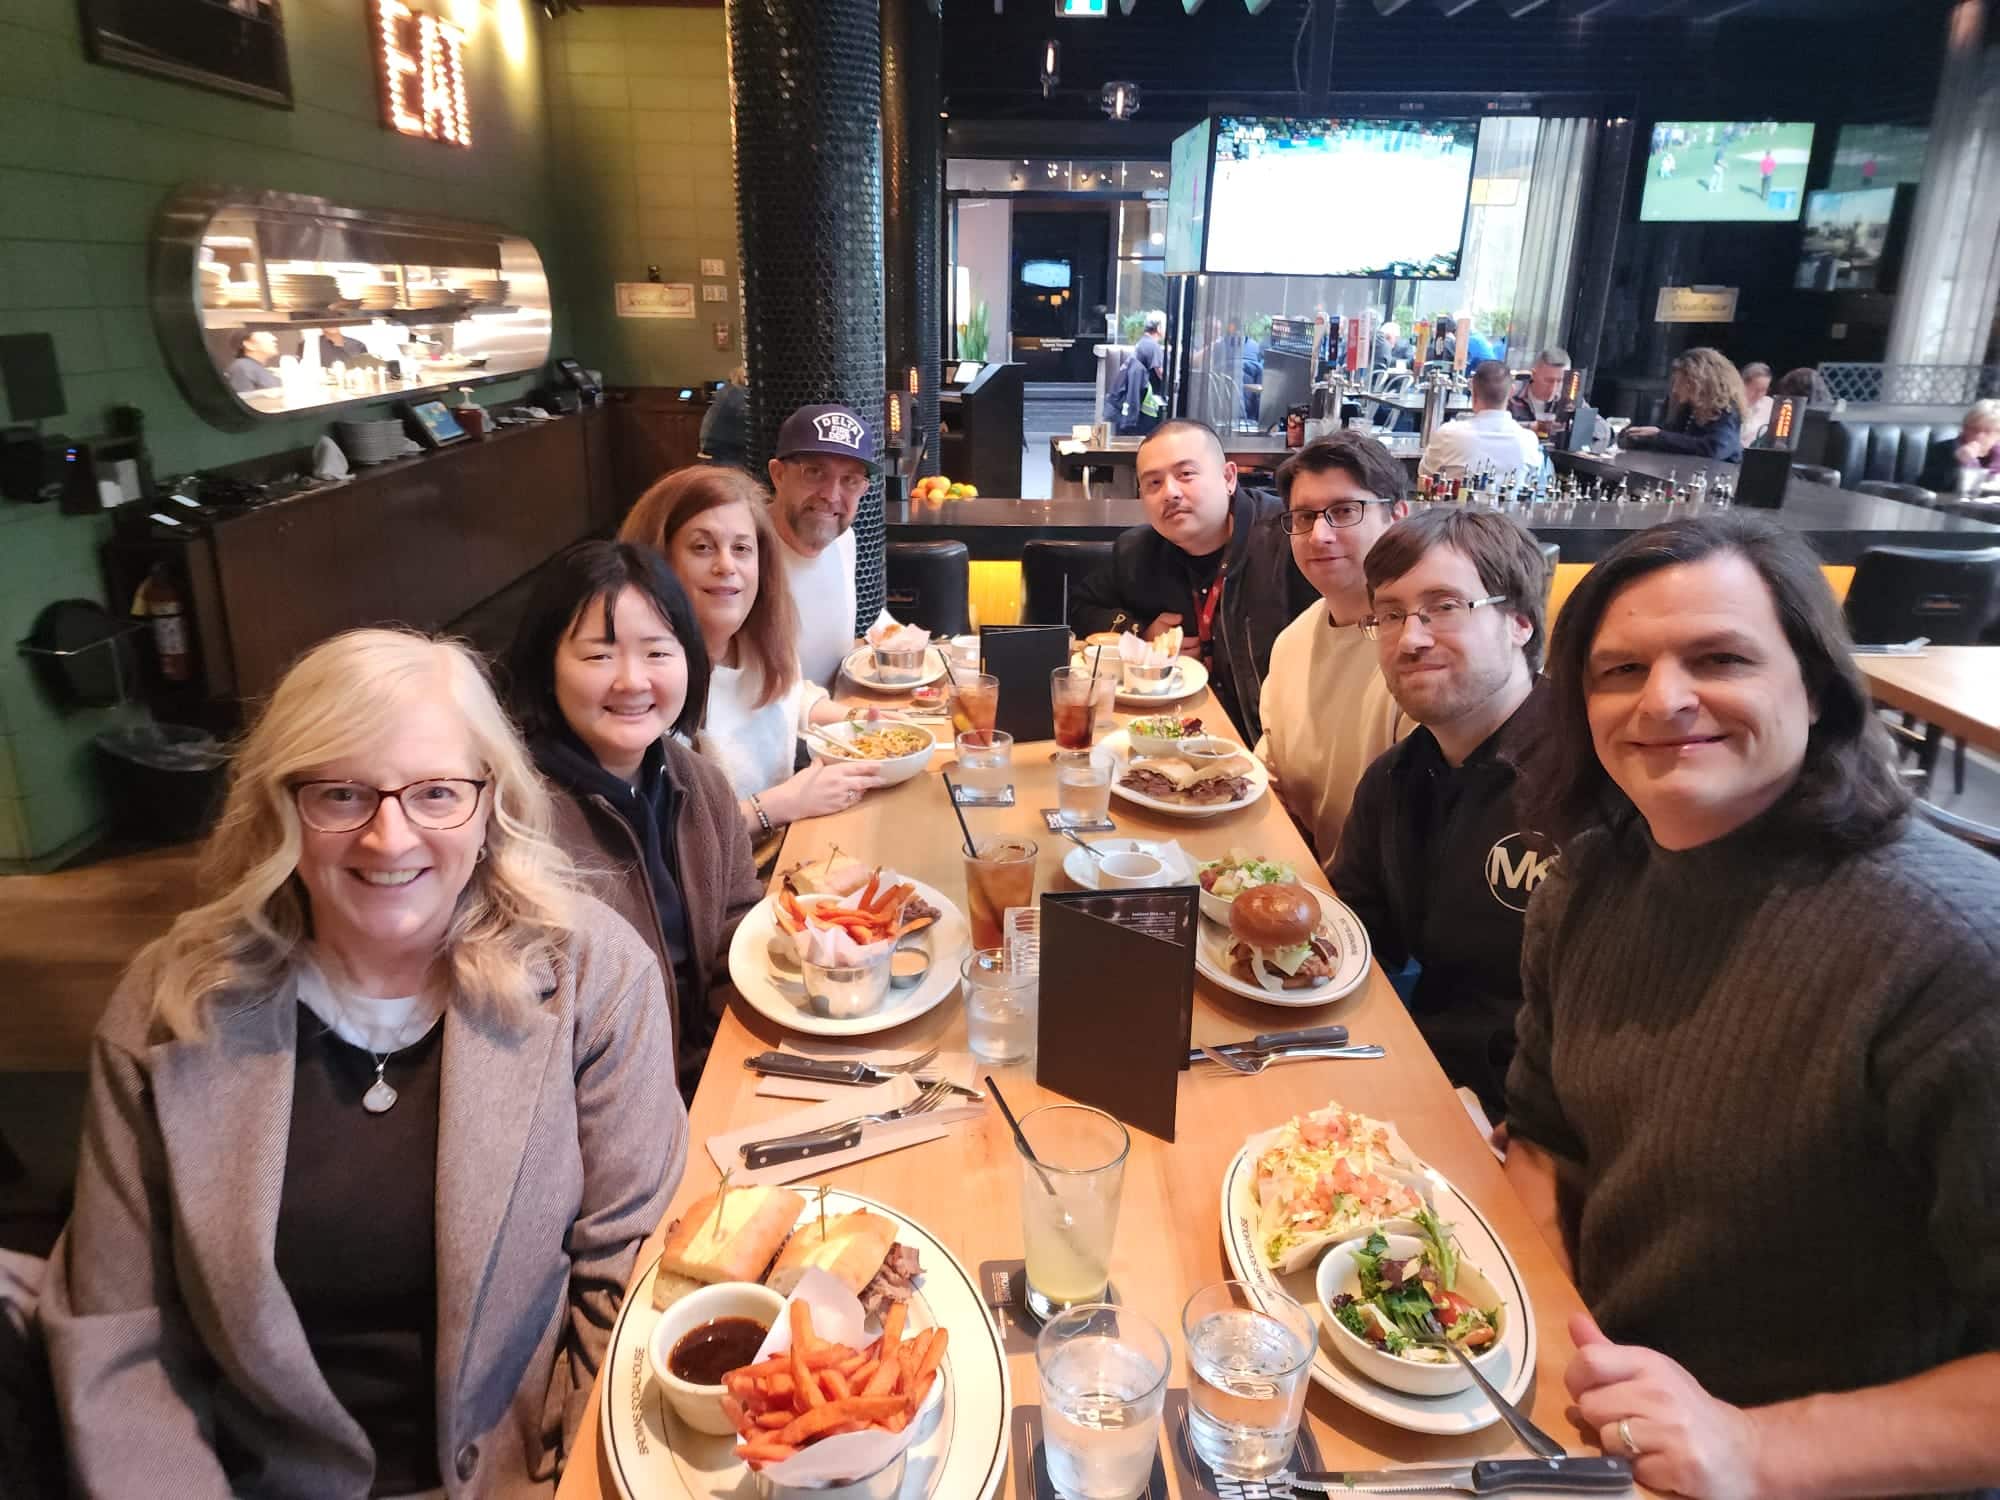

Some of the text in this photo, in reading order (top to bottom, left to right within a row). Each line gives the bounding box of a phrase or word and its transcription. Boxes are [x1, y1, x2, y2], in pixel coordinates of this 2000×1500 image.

[379, 0, 472, 146] EAT
[821, 415, 859, 436] DELTA
[831, 425, 850, 435] FIRE
[631, 1411, 650, 1455] BROWNS
